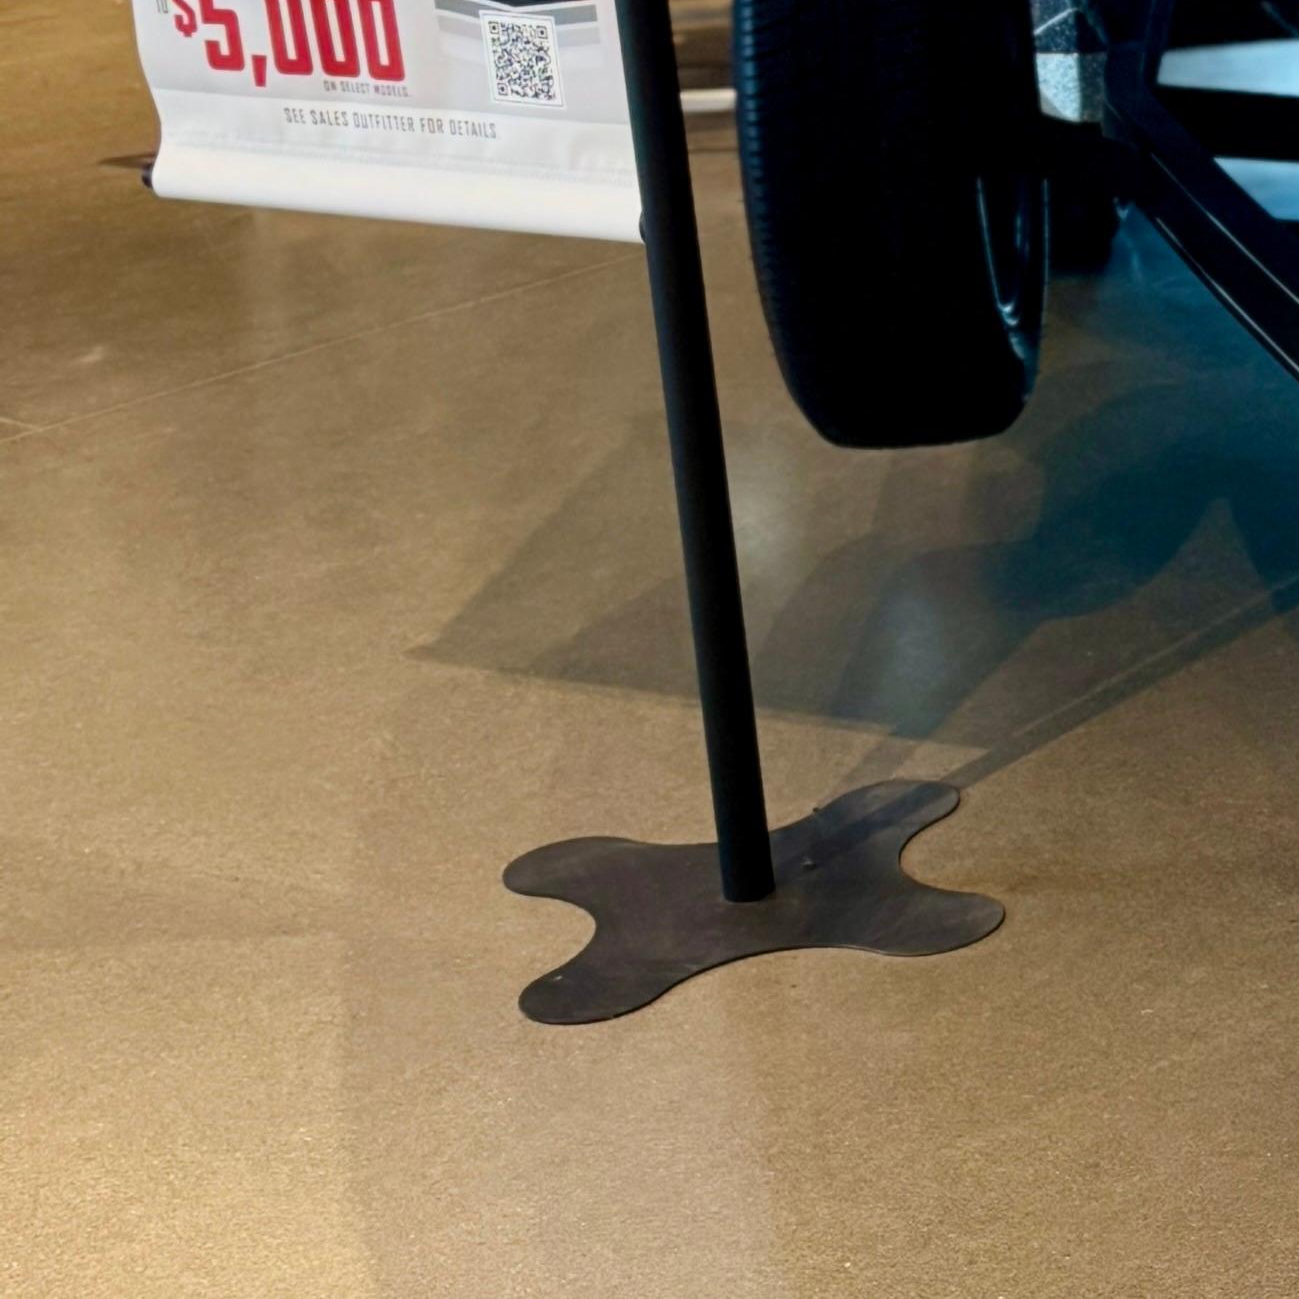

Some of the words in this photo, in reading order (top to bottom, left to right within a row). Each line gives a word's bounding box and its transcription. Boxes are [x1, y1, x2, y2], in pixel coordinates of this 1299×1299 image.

[284, 107, 306, 124] SEE
[310, 109, 349, 126] SALES
[353, 112, 415, 132] OUTFITTER
[420, 118, 444, 134] FOR
